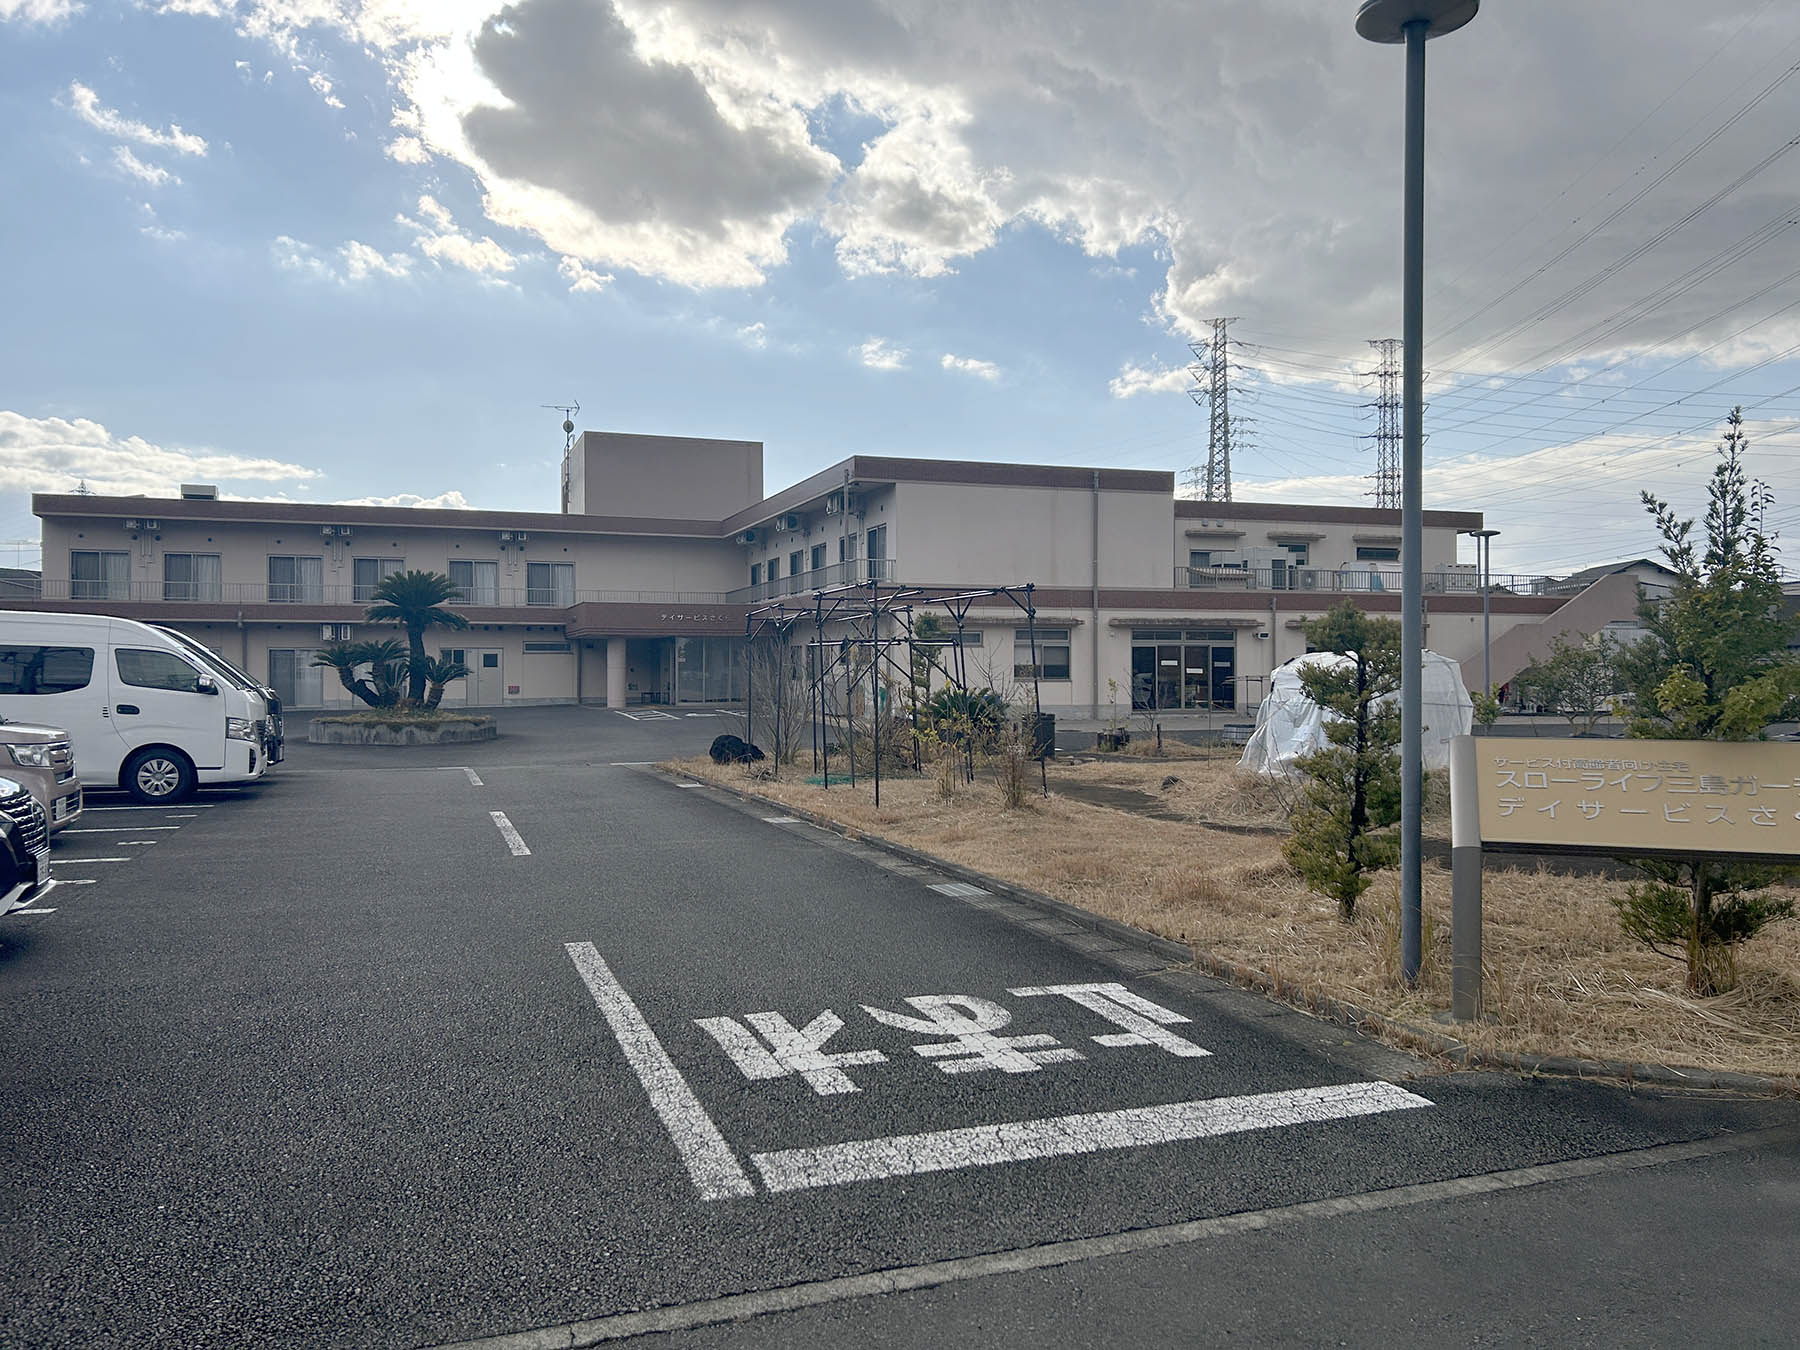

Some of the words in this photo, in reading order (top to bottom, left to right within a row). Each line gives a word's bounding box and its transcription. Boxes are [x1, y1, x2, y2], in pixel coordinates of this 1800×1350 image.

[1495, 770, 1800, 796] スローライフ三島ガー
[693, 981, 1214, 1097] 止まれ
